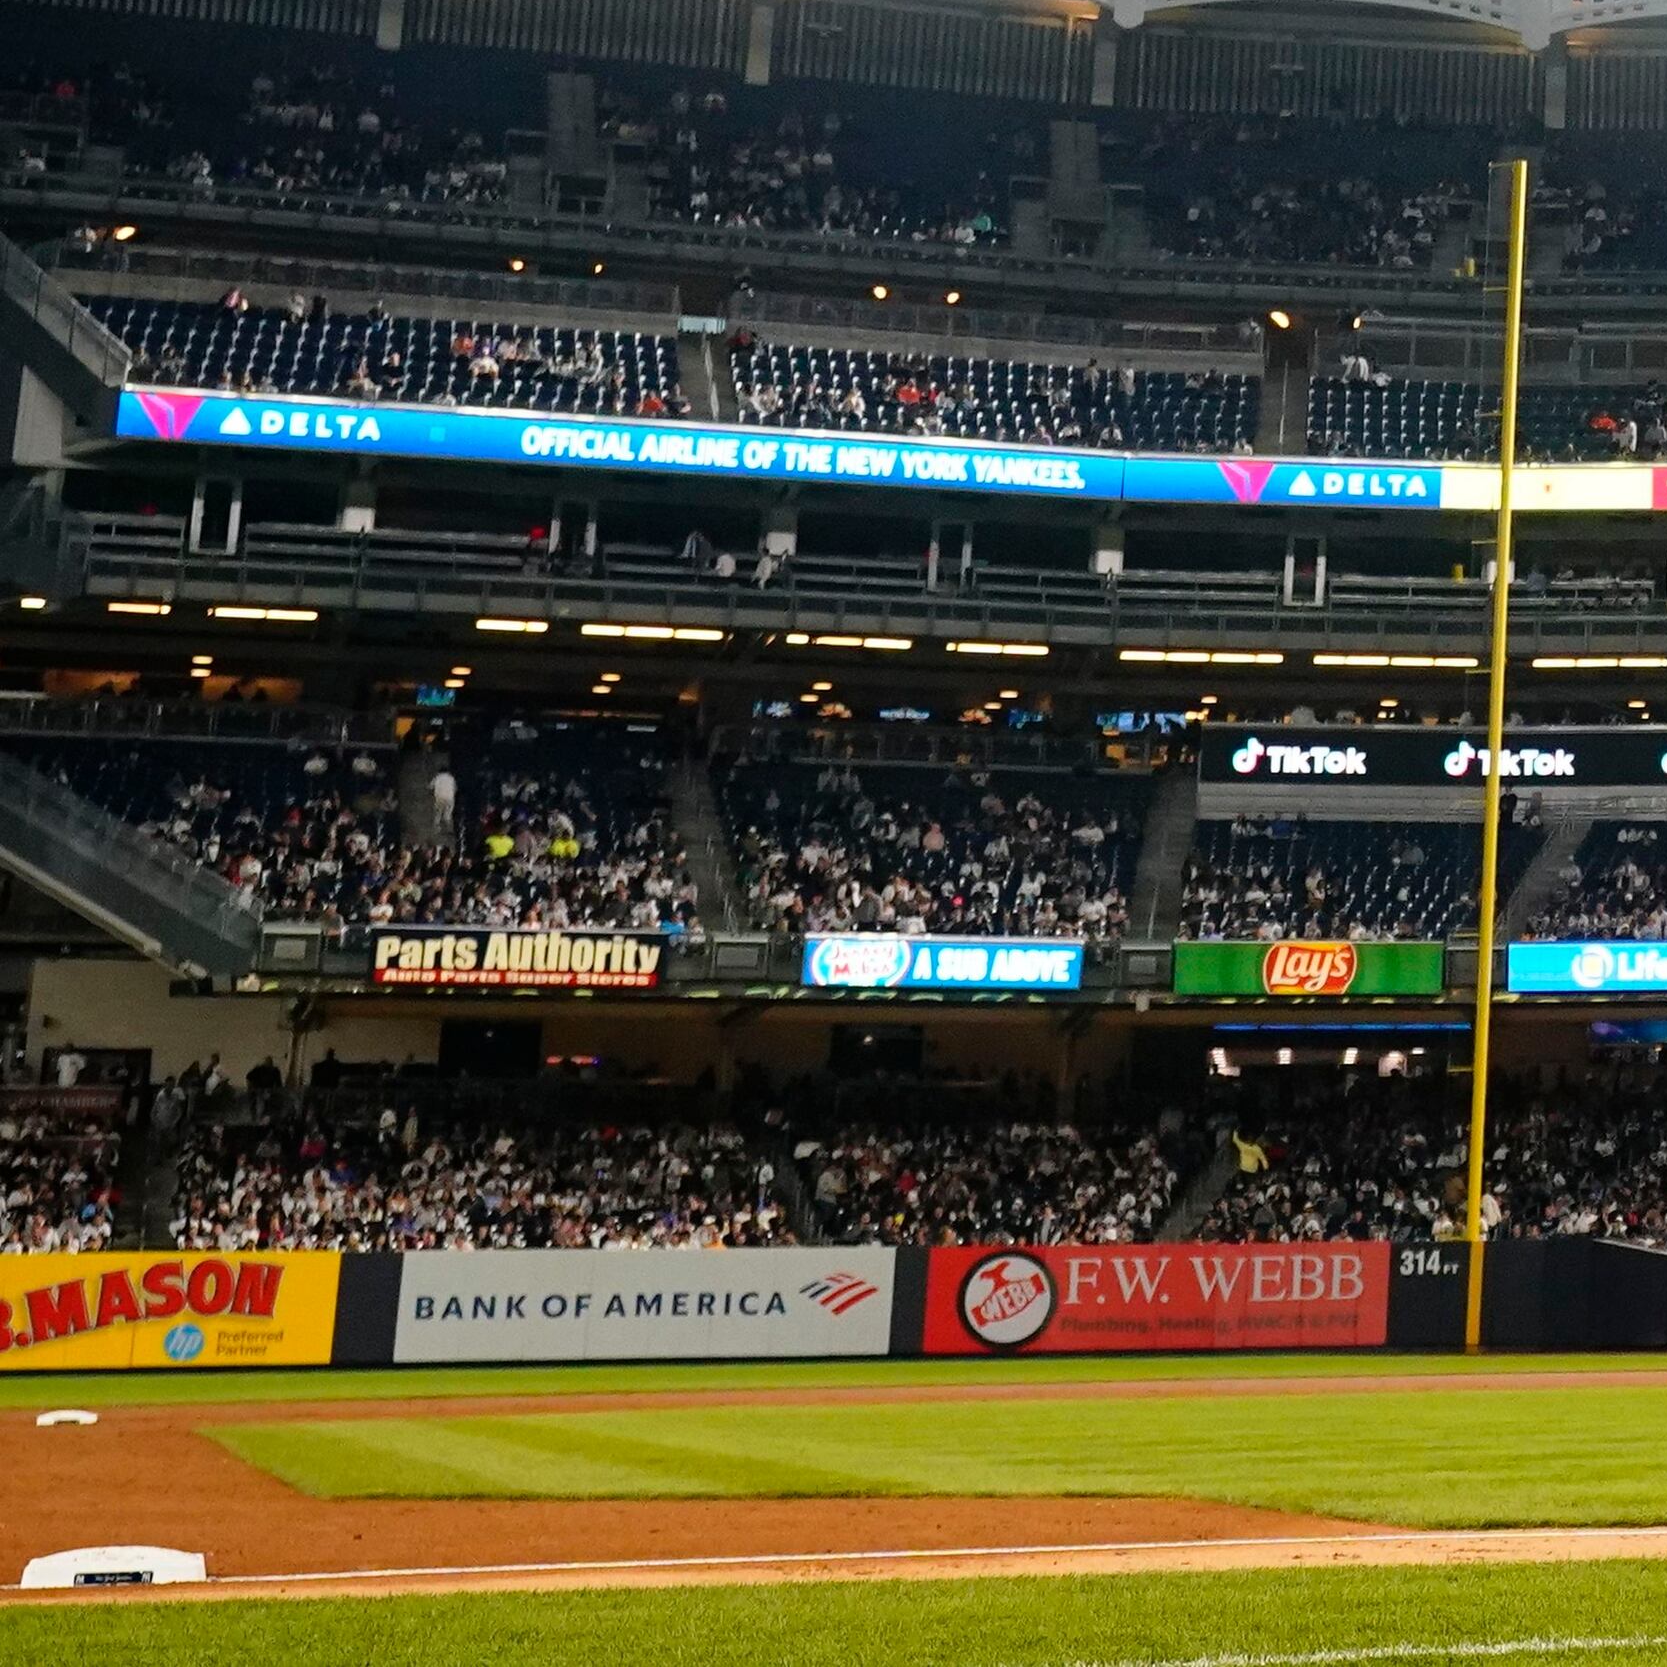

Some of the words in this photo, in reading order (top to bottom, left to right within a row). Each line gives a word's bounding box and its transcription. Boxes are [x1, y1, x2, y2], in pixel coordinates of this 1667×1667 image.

[260, 409, 381, 441] DELTA
[521, 426, 634, 461] OFFICIAL
[638, 433, 738, 468] AIRLINE
[743, 440, 779, 470] OF
[783, 442, 832, 474] THE
[836, 446, 899, 478] NEW
[898, 449, 968, 482] YORK
[1323, 474, 1427, 498] DELTA
[1266, 745, 1366, 774] TikTok
[1477, 749, 1575, 776] TkTok
[375, 935, 478, 971] Parts
[482, 932, 660, 974] Authority
[912, 948, 933, 981] A
[936, 948, 988, 981] SUB
[990, 948, 1076, 982] ABOVE
[381, 970, 436, 983] Auto
[441, 970, 500, 983] Parts
[505, 971, 573, 984] Super
[576, 972, 650, 986] Stores
[1270, 946, 1350, 992] Lay's
[1400, 1250, 1441, 1276] 314
[1443, 1264, 1459, 1275] FT
[1189, 1255, 1364, 1303] WEBB
[415, 1295, 527, 1320] BANK
[541, 1294, 593, 1319] OF
[605, 1292, 787, 1319] AMERICA
[980, 1282, 1037, 1322] WEBB
[216, 1345, 268, 1357] Partner
[217, 1331, 285, 1344] Preferred
